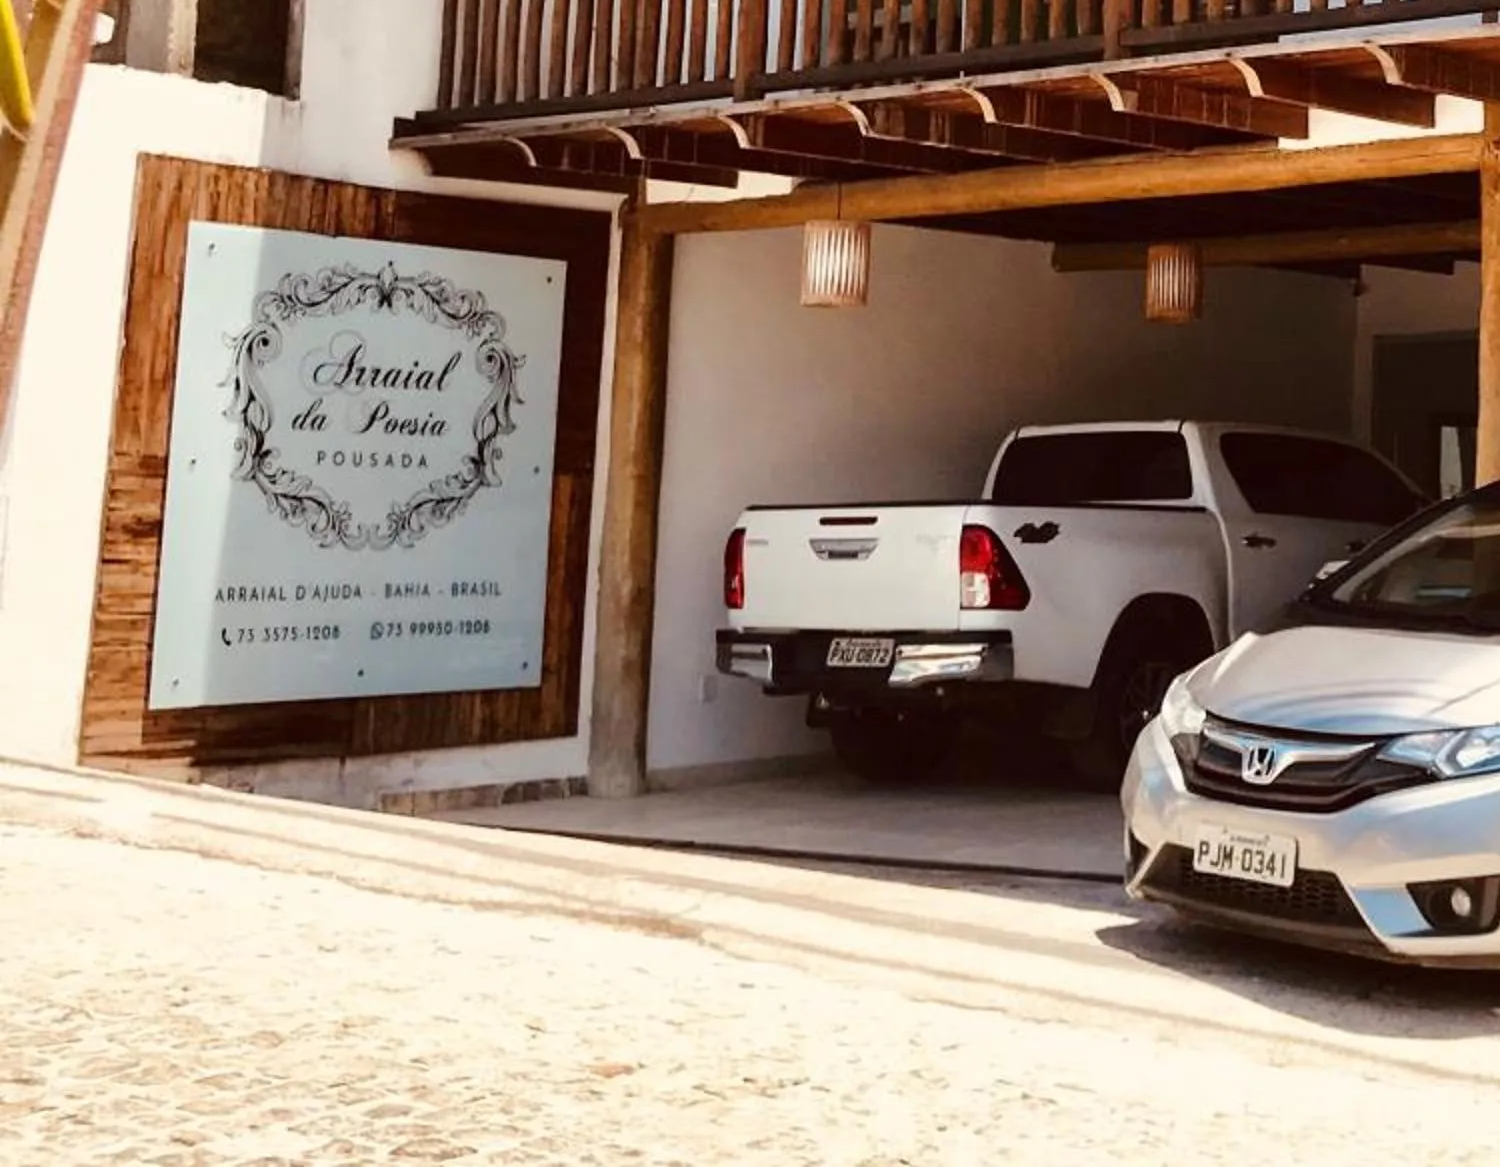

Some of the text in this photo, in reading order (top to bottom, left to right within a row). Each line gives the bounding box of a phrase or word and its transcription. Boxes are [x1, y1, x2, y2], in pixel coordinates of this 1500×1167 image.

[313, 342, 463, 392] Arraial
[291, 397, 448, 437] da Poesia
[316, 449, 430, 470] POUSADA
[214, 584, 287, 603] ARRAIAL
[384, 581, 431, 599] BAHIA
[451, 580, 502, 597] BRASIL
[237, 626, 256, 643] 73
